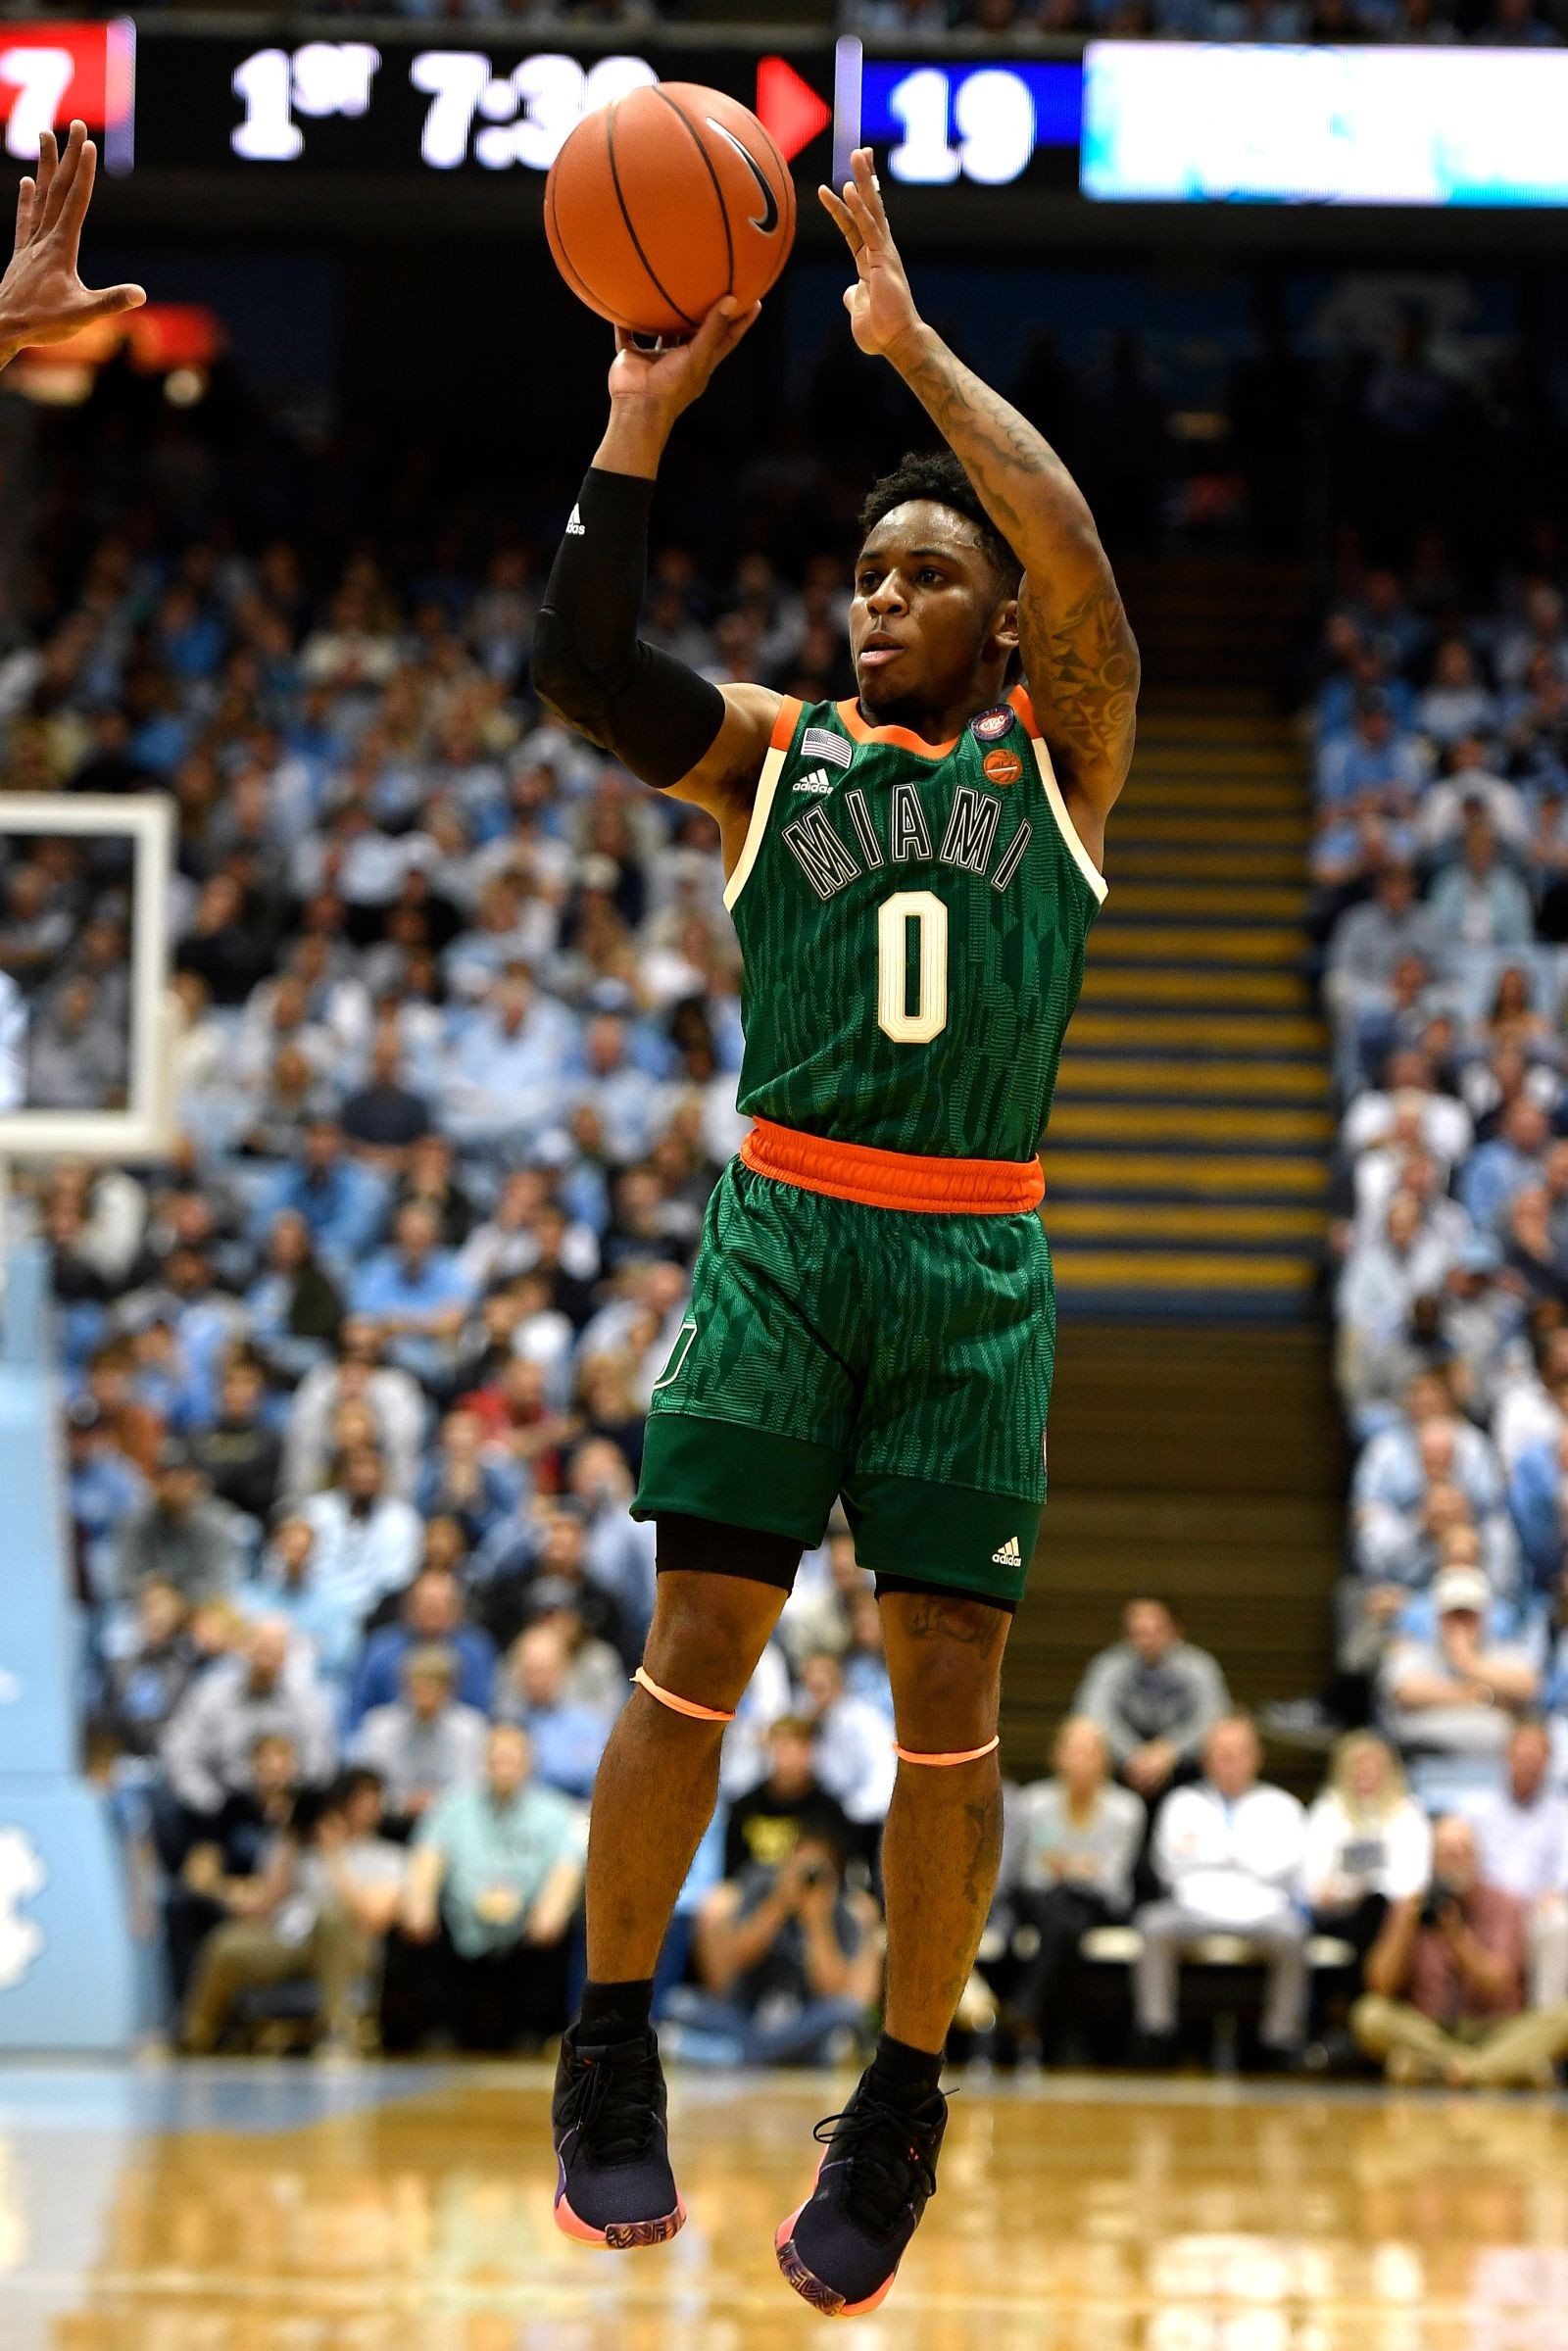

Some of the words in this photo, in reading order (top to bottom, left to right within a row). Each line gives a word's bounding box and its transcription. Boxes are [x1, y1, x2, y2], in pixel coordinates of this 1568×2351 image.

[888, 68, 1036, 185] 19
[781, 783, 1033, 901] MIAMI
[792, 781, 834, 795] adidas
[878, 891, 949, 1044] 0
[992, 1552, 1022, 1567] adidas
